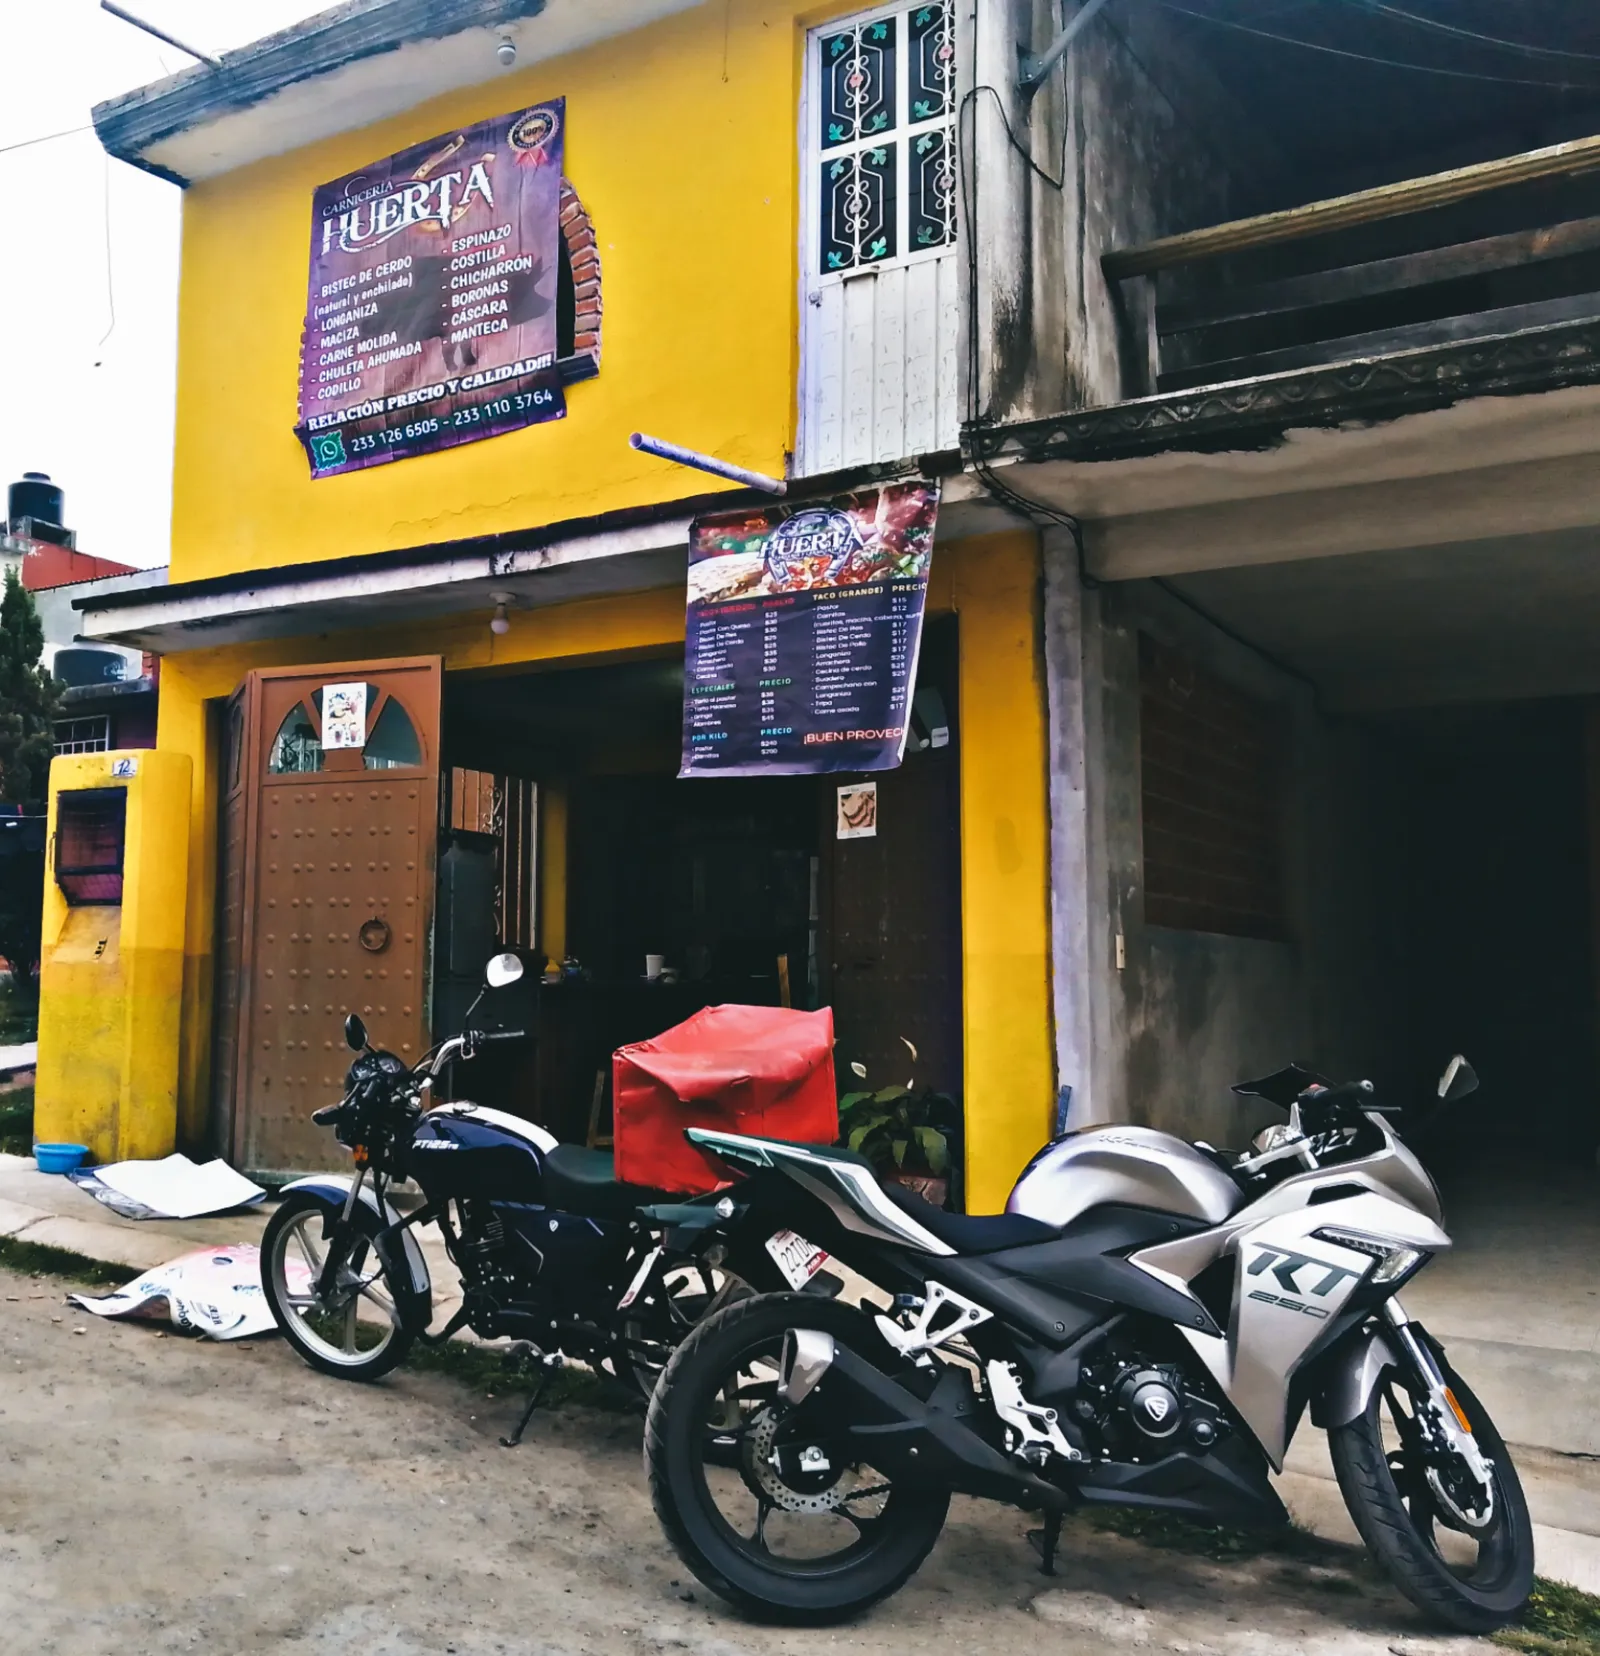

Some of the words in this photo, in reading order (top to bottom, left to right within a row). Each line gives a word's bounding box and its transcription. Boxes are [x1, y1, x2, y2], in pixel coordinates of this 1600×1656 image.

[321, 162, 495, 256] HUERTA
[322, 180, 394, 217] CARNICERÍA
[451, 223, 512, 253] ESPINAZO
[450, 244, 506, 272] COSTILLA
[450, 254, 532, 289] CHICHARRÓN
[321, 275, 356, 298] BISTEC
[358, 268, 372, 283] DE
[375, 255, 412, 278] CERDO
[314, 293, 351, 320] (natural
[353, 296, 360, 306] y
[451, 279, 509, 308] BORONAS
[321, 301, 379, 332] LONGANIZA
[451, 299, 508, 327] CÁSCARA
[320, 326, 360, 349] MACIZA
[451, 318, 508, 344] MANTECA
[318, 359, 364, 383] CHULETA
[367, 341, 422, 370] AHUMADA
[319, 344, 354, 367] CARNE
[357, 331, 398, 355] MOLIDA
[307, 399, 384, 431] RELACIÓN
[387, 384, 445, 410] PRECIO
[447, 379, 459, 393] Y
[460, 353, 553, 391] CALIDAD!!!
[317, 377, 361, 400] CODILLO
[351, 435, 376, 452] 233
[379, 427, 403, 444] 126
[405, 418, 439, 438] 6505
[453, 407, 480, 426] 233
[484, 399, 510, 418] 110
[514, 388, 553, 410] 3764
[758, 518, 865, 560] HUERTA
[812, 591, 836, 601] TACO
[838, 586, 884, 598] (GRANDE)
[691, 683, 736, 695] ESPECIALES
[759, 677, 792, 687] PRECIO
[708, 732, 728, 740] KILO
[760, 726, 793, 737] PRECIO
[803, 731, 844, 745] ¡BUEN
